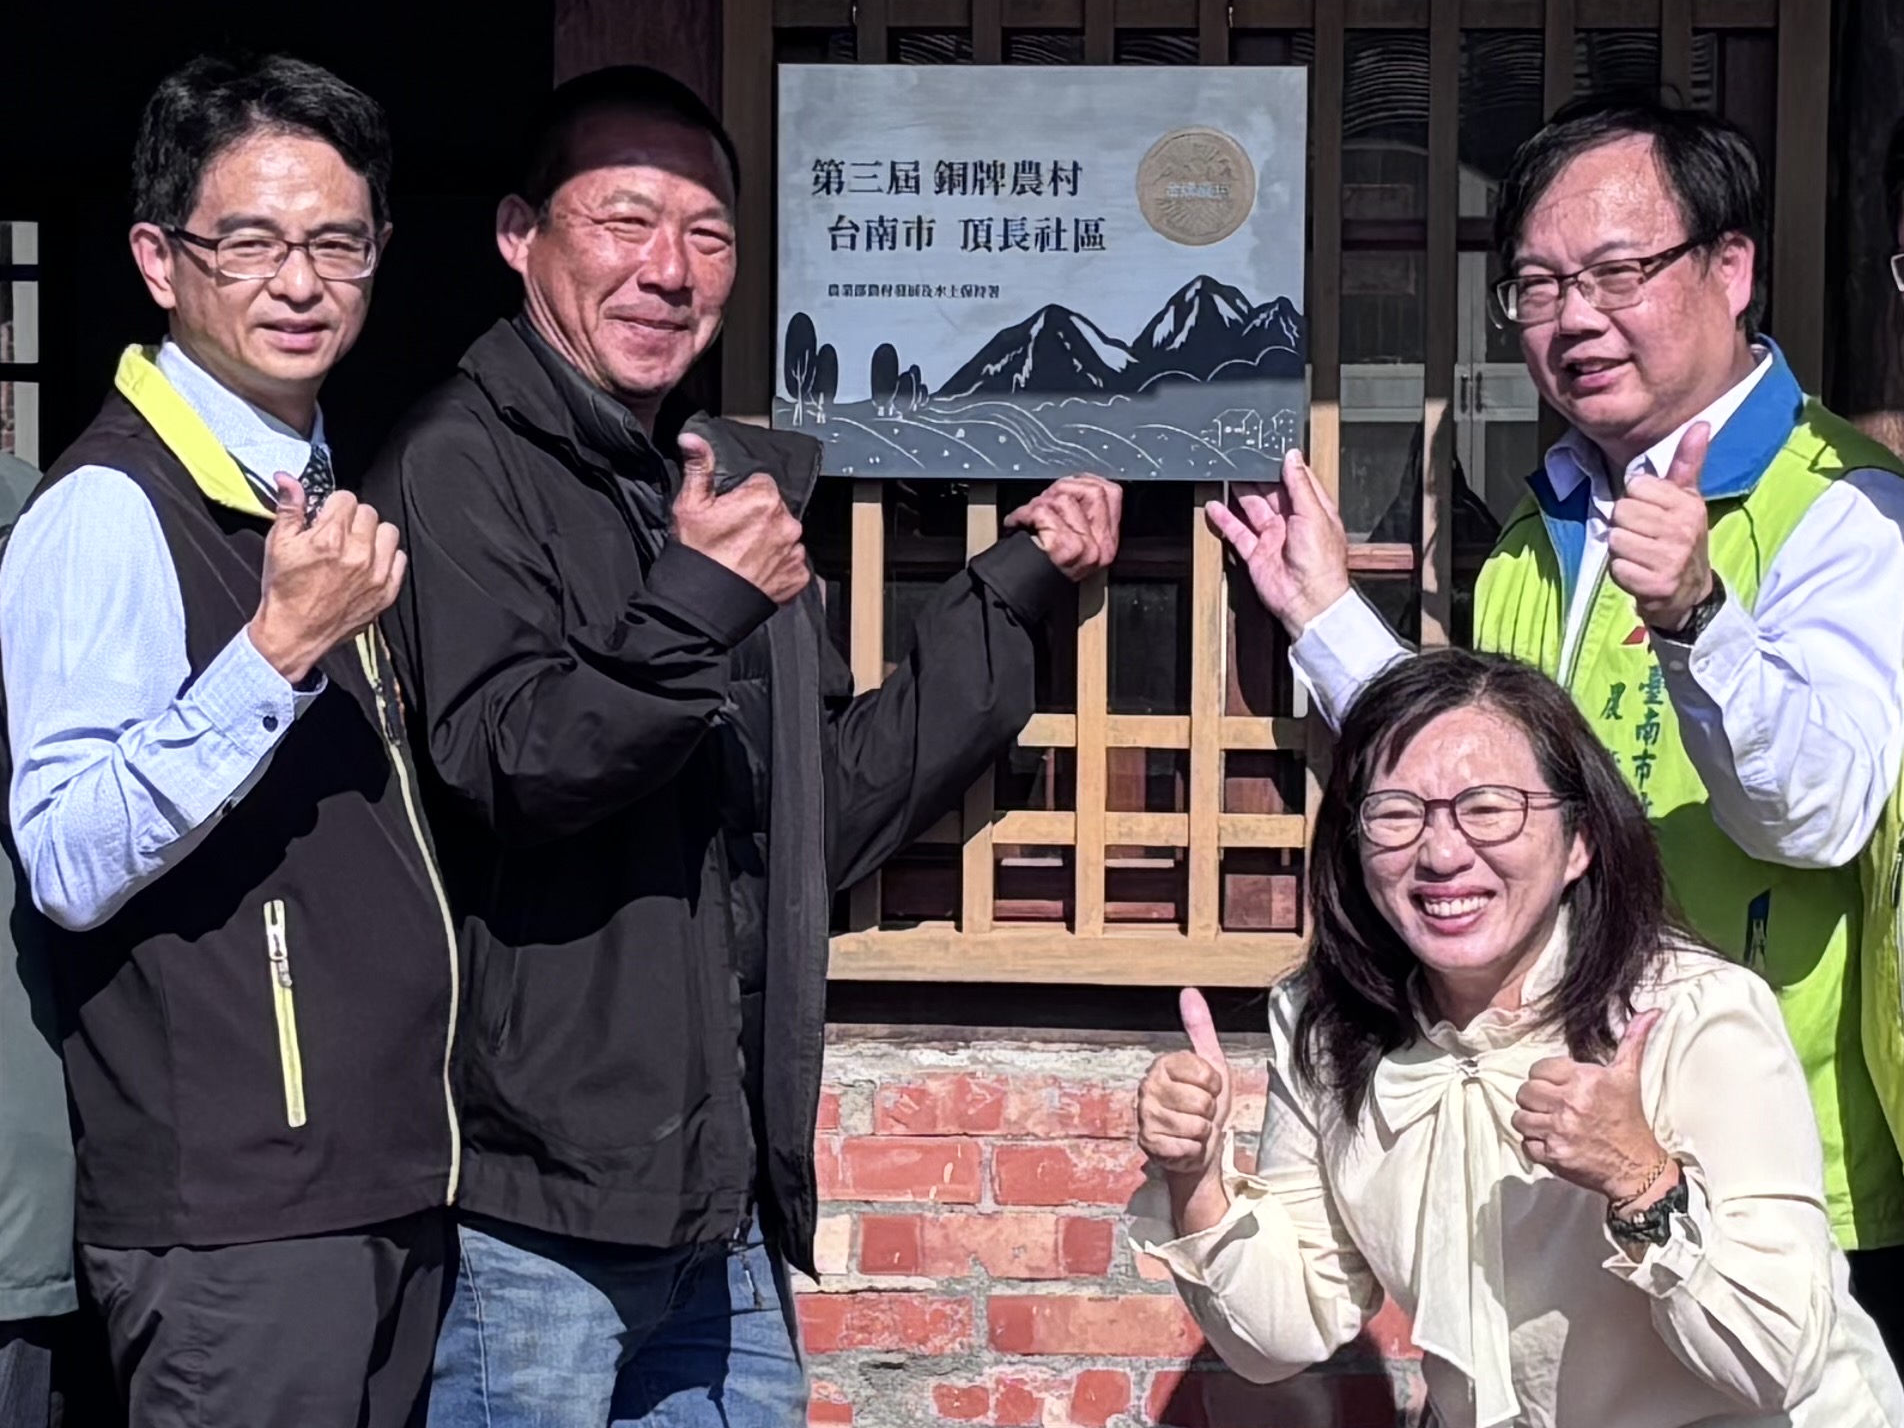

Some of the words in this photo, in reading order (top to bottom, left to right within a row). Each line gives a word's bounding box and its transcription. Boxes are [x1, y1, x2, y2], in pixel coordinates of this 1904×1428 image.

[810, 157, 922, 197] 第三屆
[933, 158, 1084, 197] 銅牌農村
[826, 215, 936, 253] 台南市
[959, 215, 1107, 254] 頂長社區
